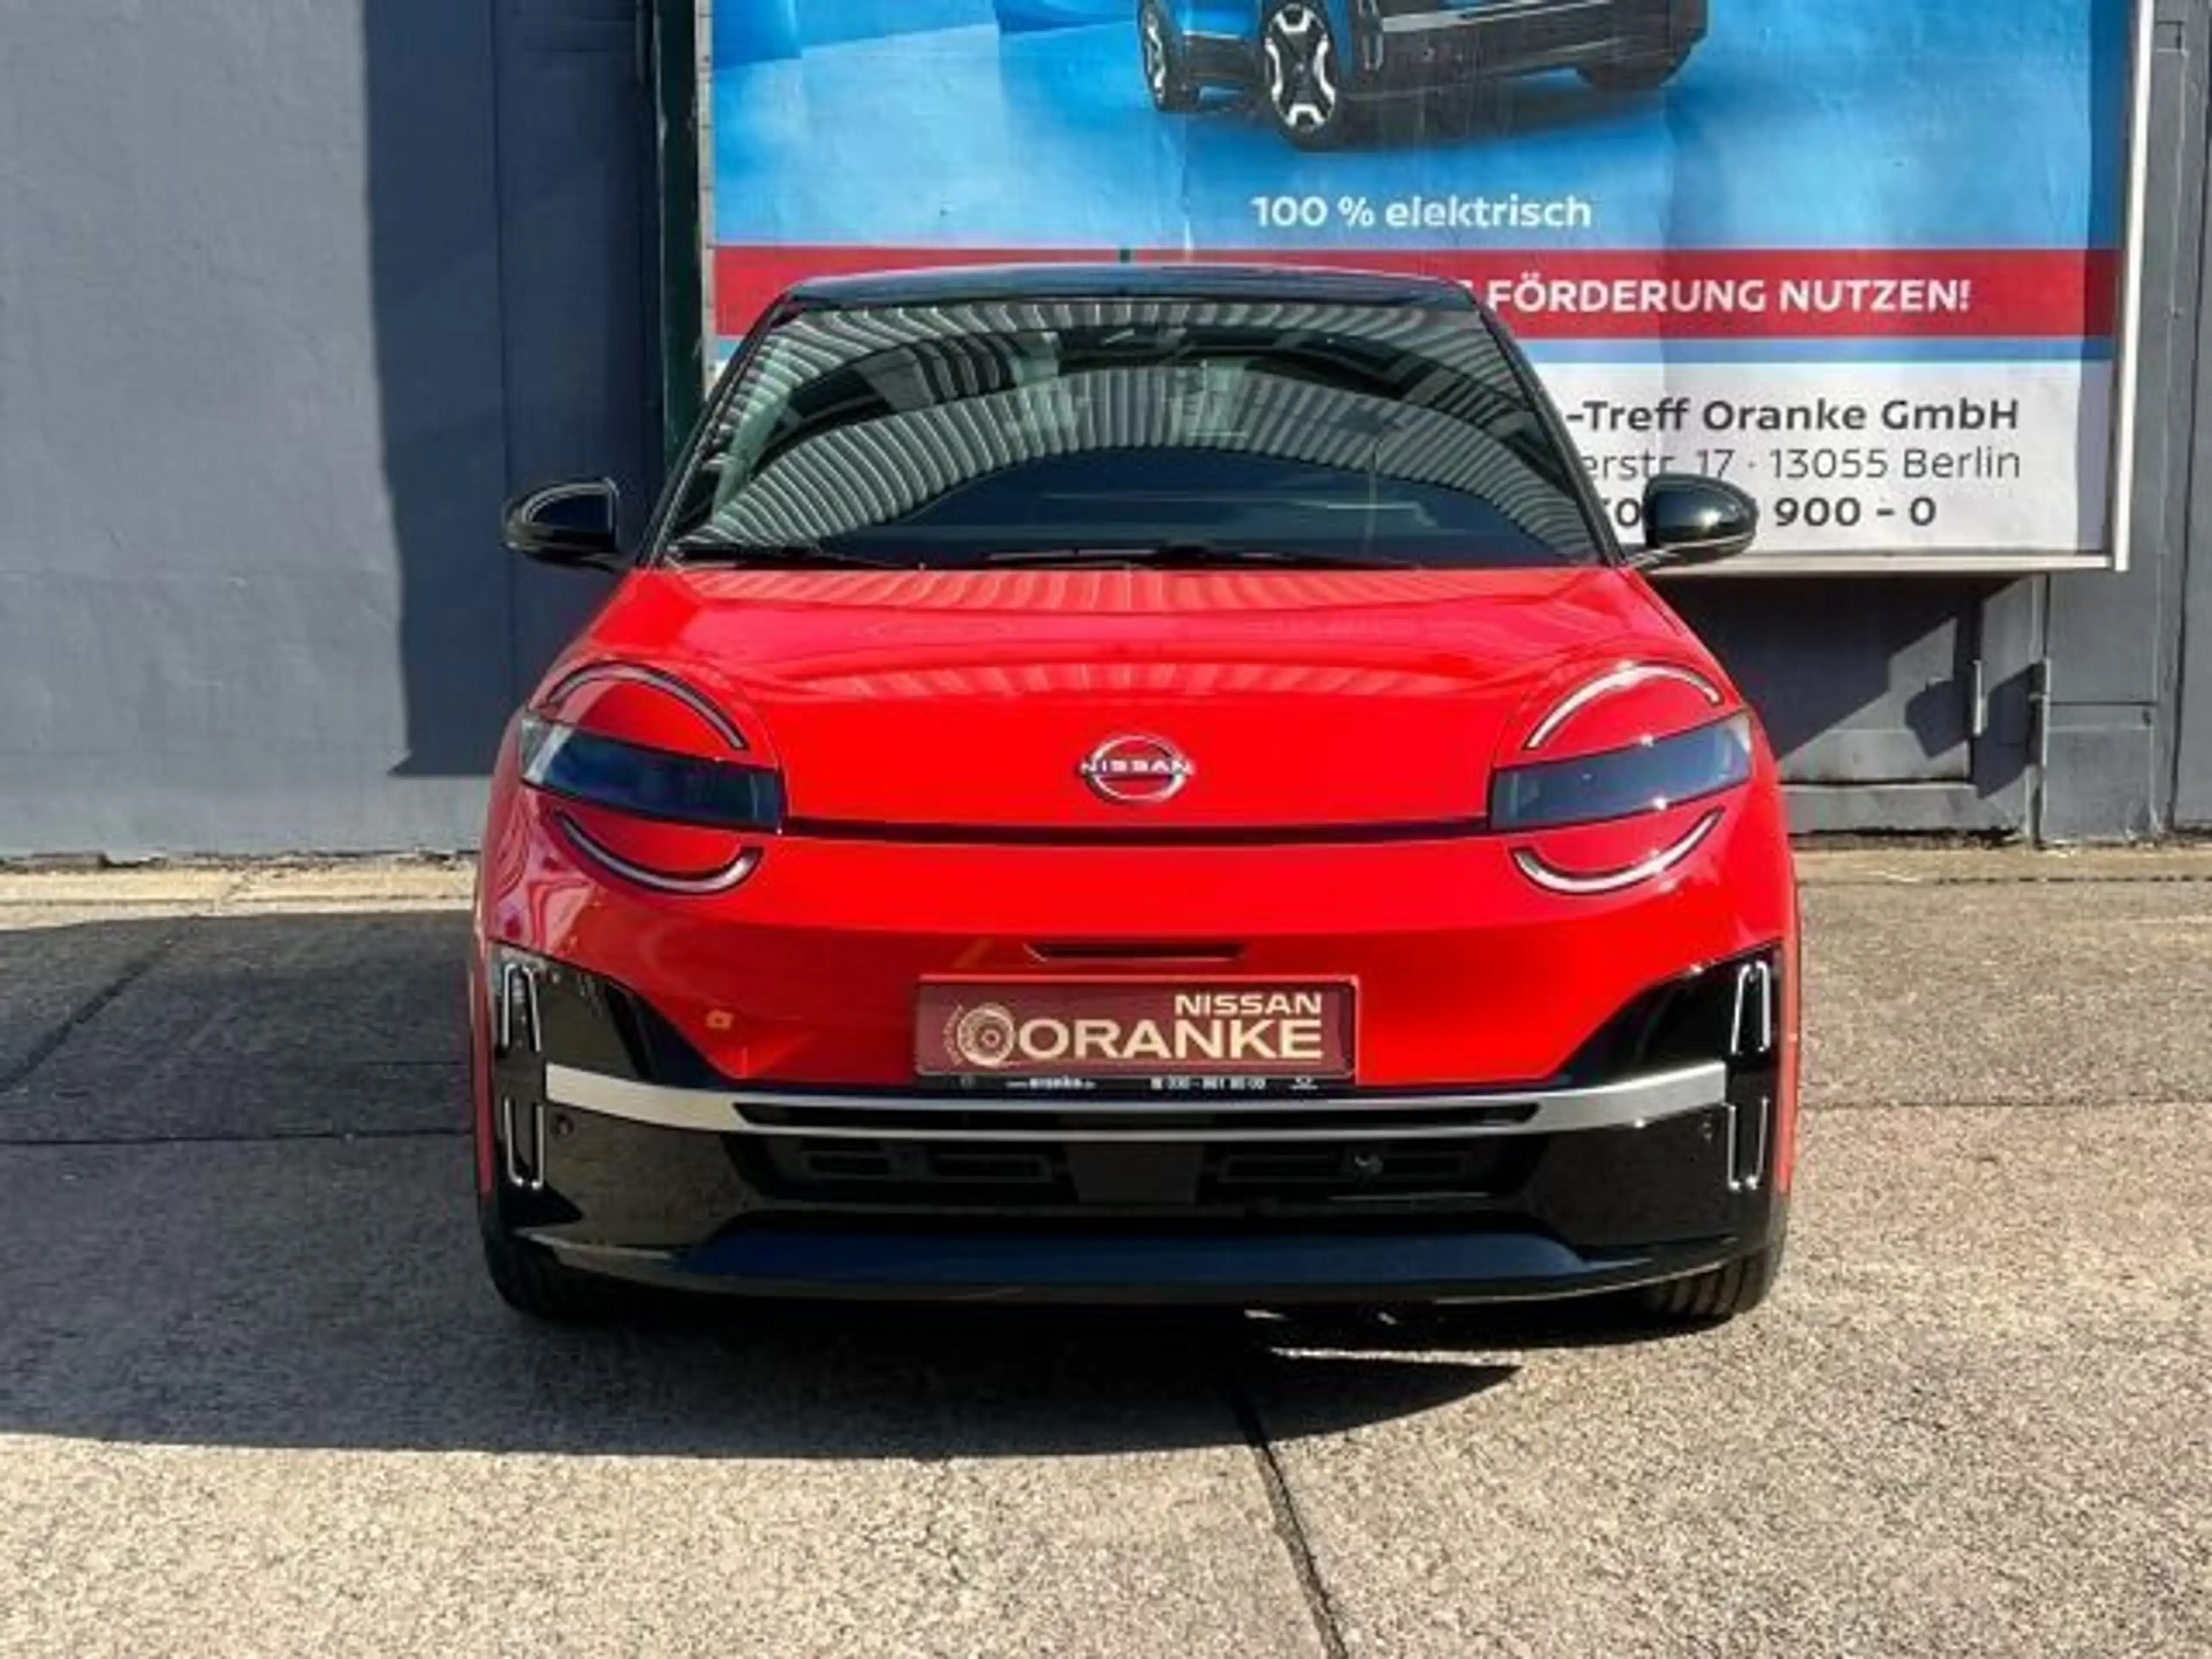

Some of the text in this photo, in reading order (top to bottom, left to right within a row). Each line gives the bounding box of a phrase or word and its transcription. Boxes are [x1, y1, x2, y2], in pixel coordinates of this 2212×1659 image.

[1252, 194, 1592, 228] 100 % elektrisch
[1486, 271, 1971, 312] FÖRDERUNG NUTZEN!
[1703, 398, 1866, 431] Oranke
[1881, 397, 2018, 430] GmbH
[1696, 448, 1736, 479] 17
[1770, 448, 1888, 479] 13055
[1903, 445, 2020, 479] Berlin
[1774, 497, 1861, 527] 900
[1909, 496, 1937, 527] 0
[1081, 759, 1194, 775] NISSAN
[1175, 993, 1321, 1017] NISSAN
[1019, 1019, 1323, 1060] ORANKE
